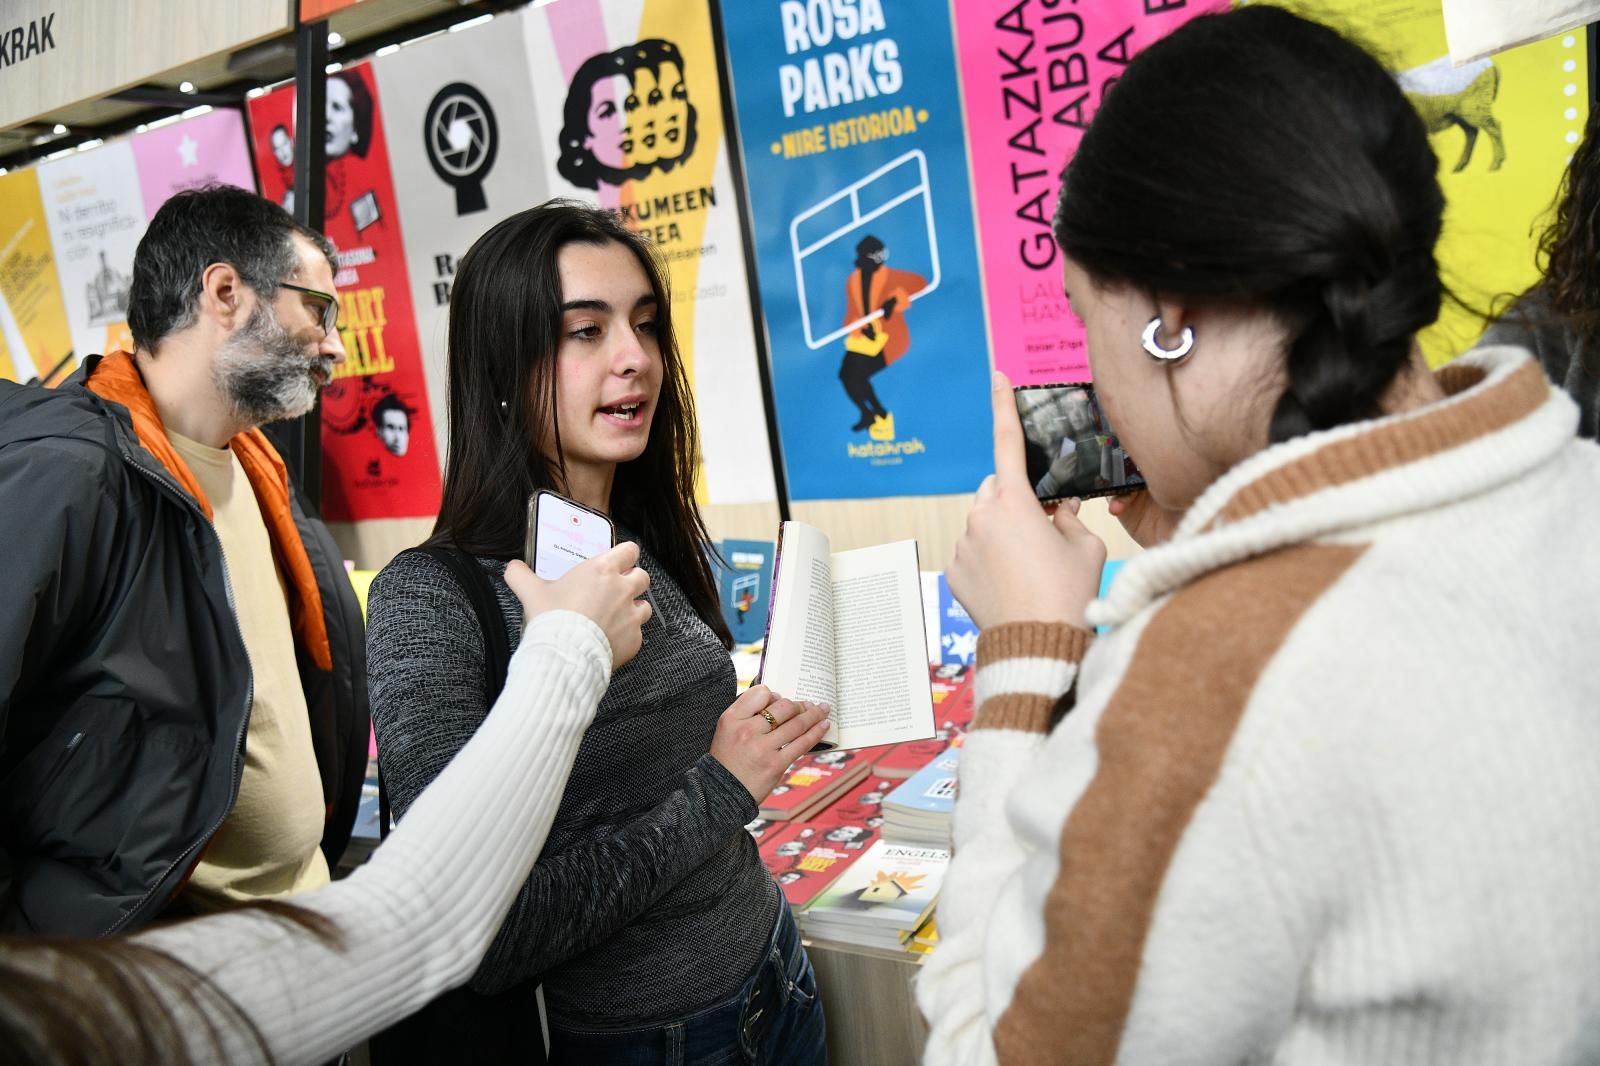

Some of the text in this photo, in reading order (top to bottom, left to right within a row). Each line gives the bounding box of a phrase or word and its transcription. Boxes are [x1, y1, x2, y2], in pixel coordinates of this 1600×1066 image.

[0, 12, 55, 69] KRAK
[780, 0, 887, 55] ROSA
[779, 38, 903, 118] PARKS
[782, 105, 918, 160] NIRE ISTORIOA
[995, 0, 1056, 270] GATAZKA
[612, 186, 717, 222] KUMEEN
[885, 848, 949, 860] ENGELS
